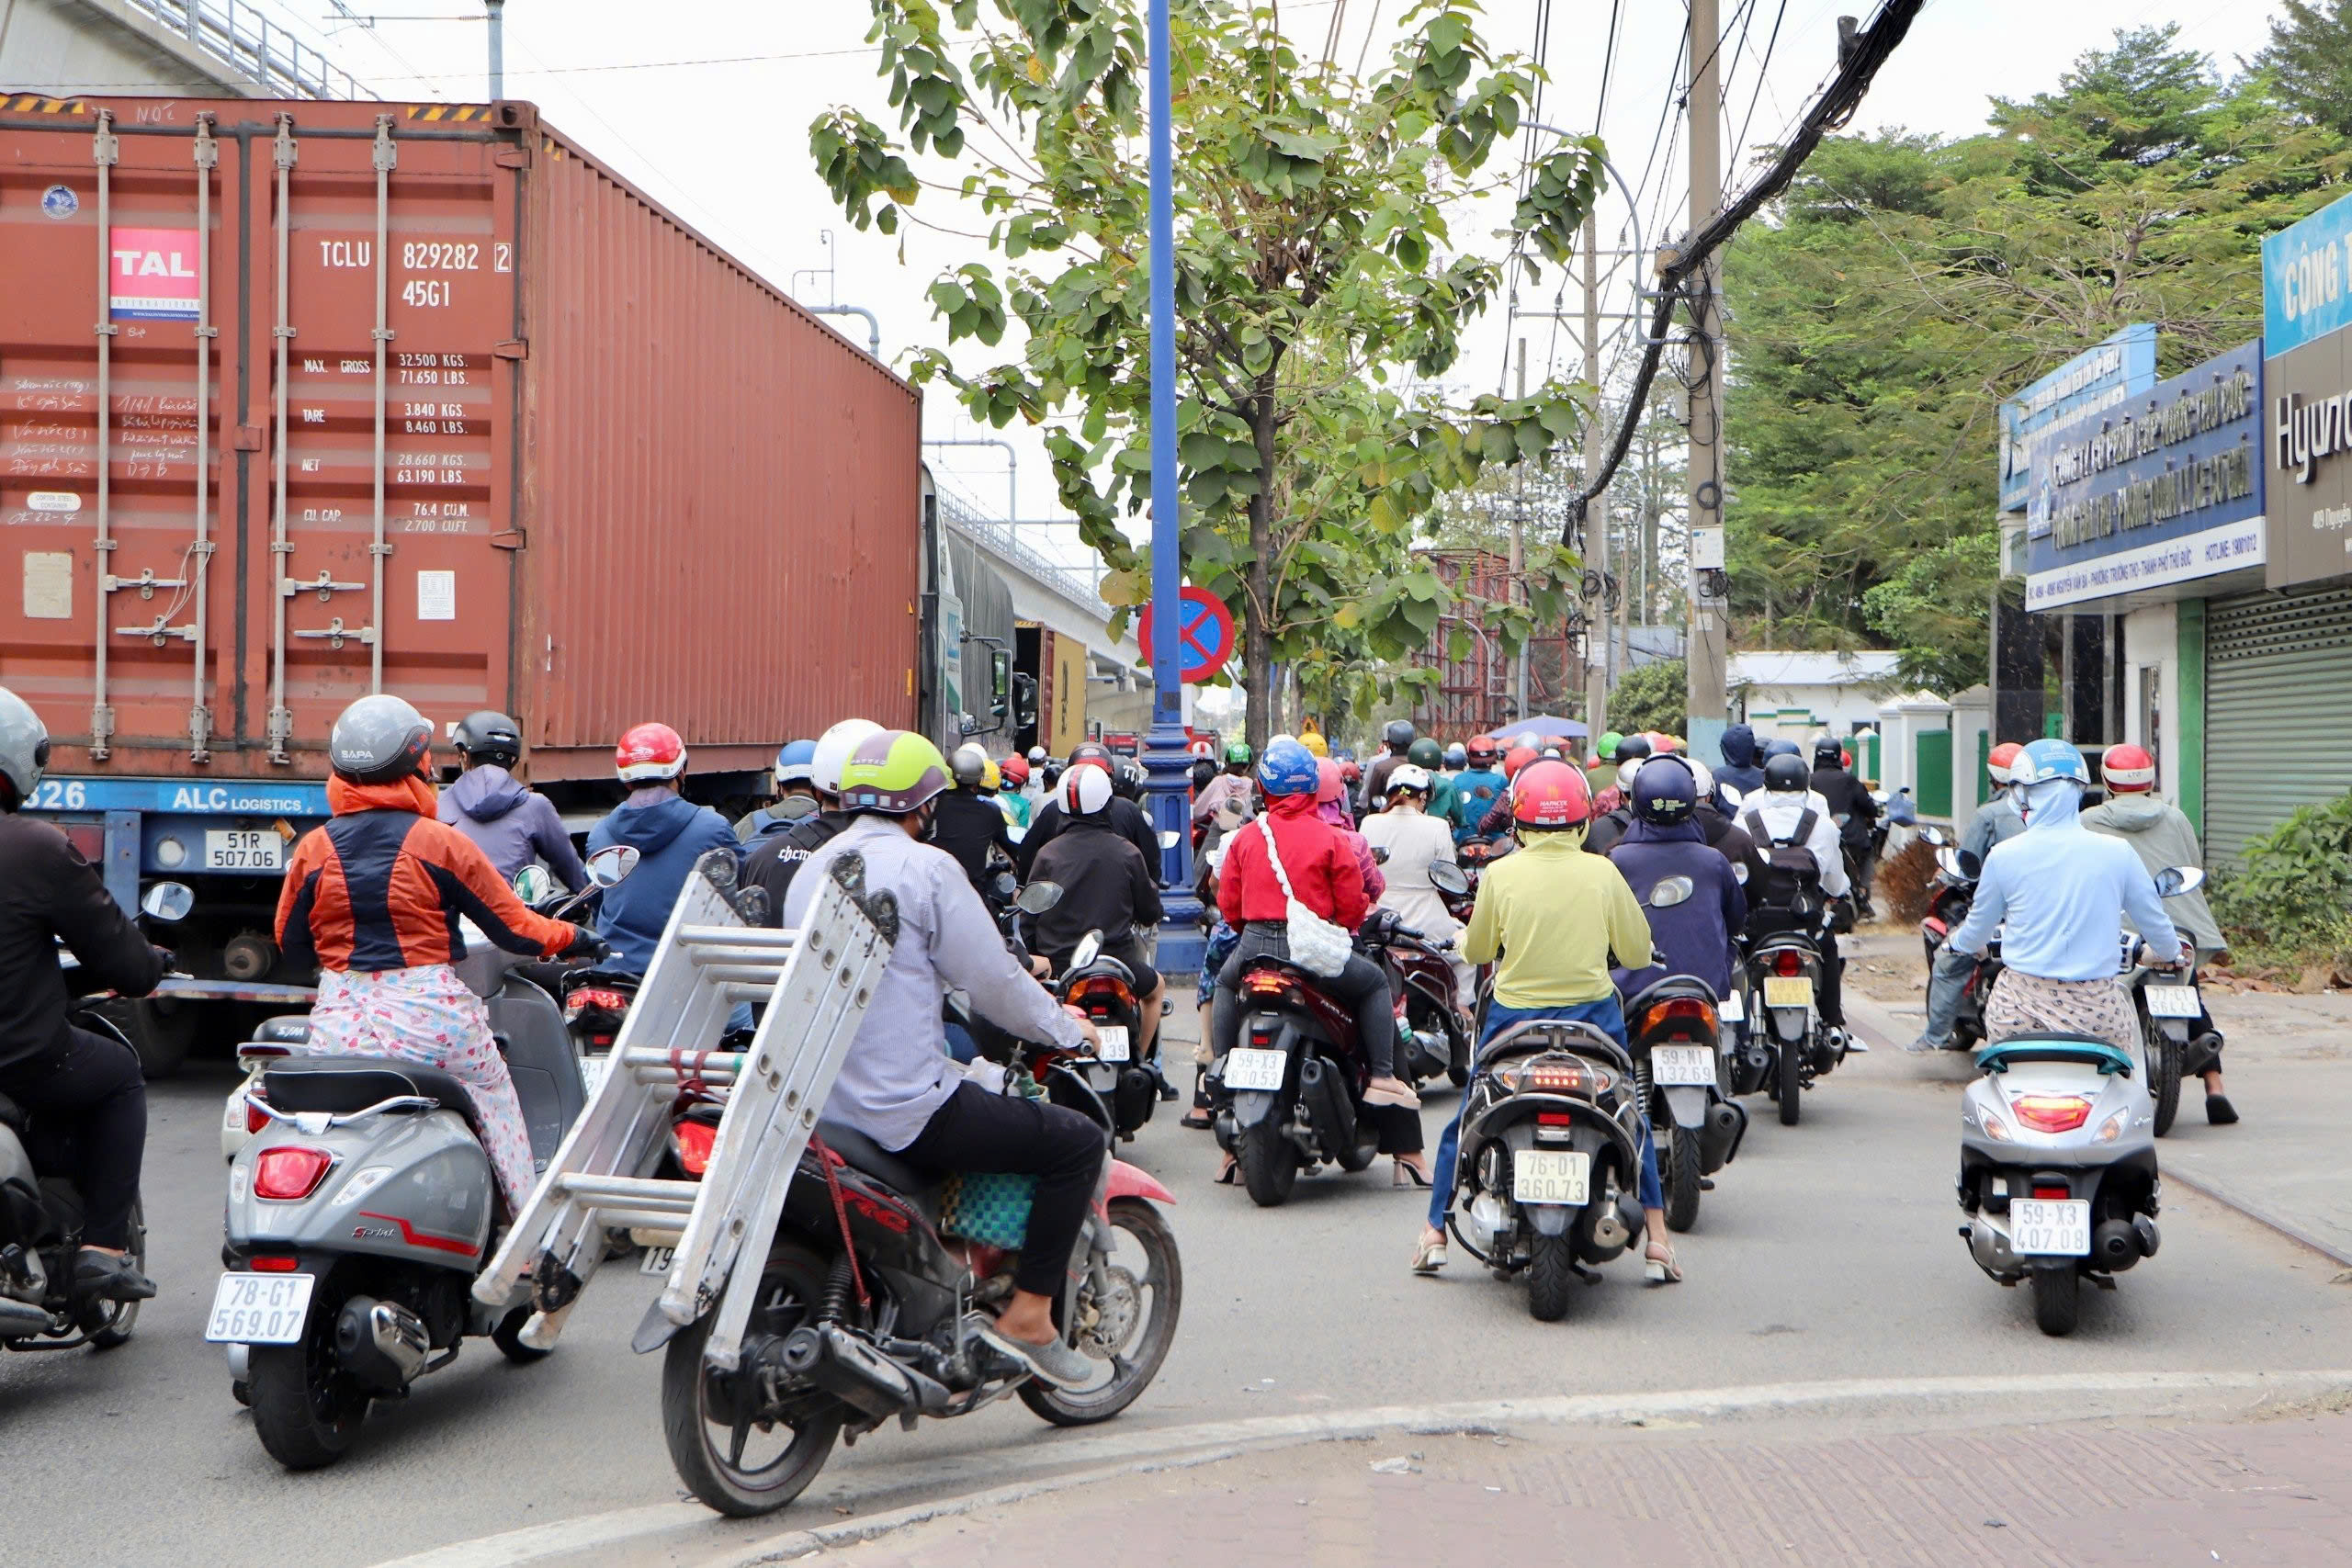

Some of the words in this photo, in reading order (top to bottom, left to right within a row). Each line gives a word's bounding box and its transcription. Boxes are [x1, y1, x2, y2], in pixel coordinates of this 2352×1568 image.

[113, 250, 195, 277] TAL
[321, 242, 371, 267] TCLU
[403, 243, 480, 270] 829282
[496, 243, 511, 272] 2
[2286, 241, 2338, 321] CÔNG
[401, 280, 450, 307] 45G1
[304, 359, 329, 374] MAX.
[340, 359, 371, 374] GROSS
[399, 354, 437, 368] 32.500
[443, 354, 469, 368] KGS.
[400, 370, 439, 385] 71.650
[444, 370, 469, 386] LBS.
[302, 409, 326, 423] TARE
[404, 402, 435, 417] 3.840
[441, 403, 467, 417] KGS.
[405, 420, 437, 434] 8.460
[443, 421, 469, 435] LBS.
[301, 458, 321, 471] NET
[398, 454, 437, 467] 28.660
[441, 454, 467, 467] KGS.
[397, 469, 435, 483] 63.190
[441, 469, 467, 484] LBS.
[304, 509, 318, 522] CU.
[322, 509, 342, 522] CAP.
[413, 502, 437, 516] 76.4
[405, 520, 436, 532] 2.700
[340, 750, 375, 760] SAPA
[173, 787, 228, 810] ALC
[232, 798, 302, 812] LOGISTICS
[227, 832, 261, 850] 51R
[213, 851, 275, 868] 507.06
[1238, 1053, 1277, 1069] 59-X3
[1521, 1178, 1585, 1201] 360.73
[2023, 1202, 2076, 1226] 59-X3
[2016, 1228, 2084, 1250] 407.08
[231, 1279, 298, 1307] 78-G1
[214, 1308, 300, 1337] 569.07
